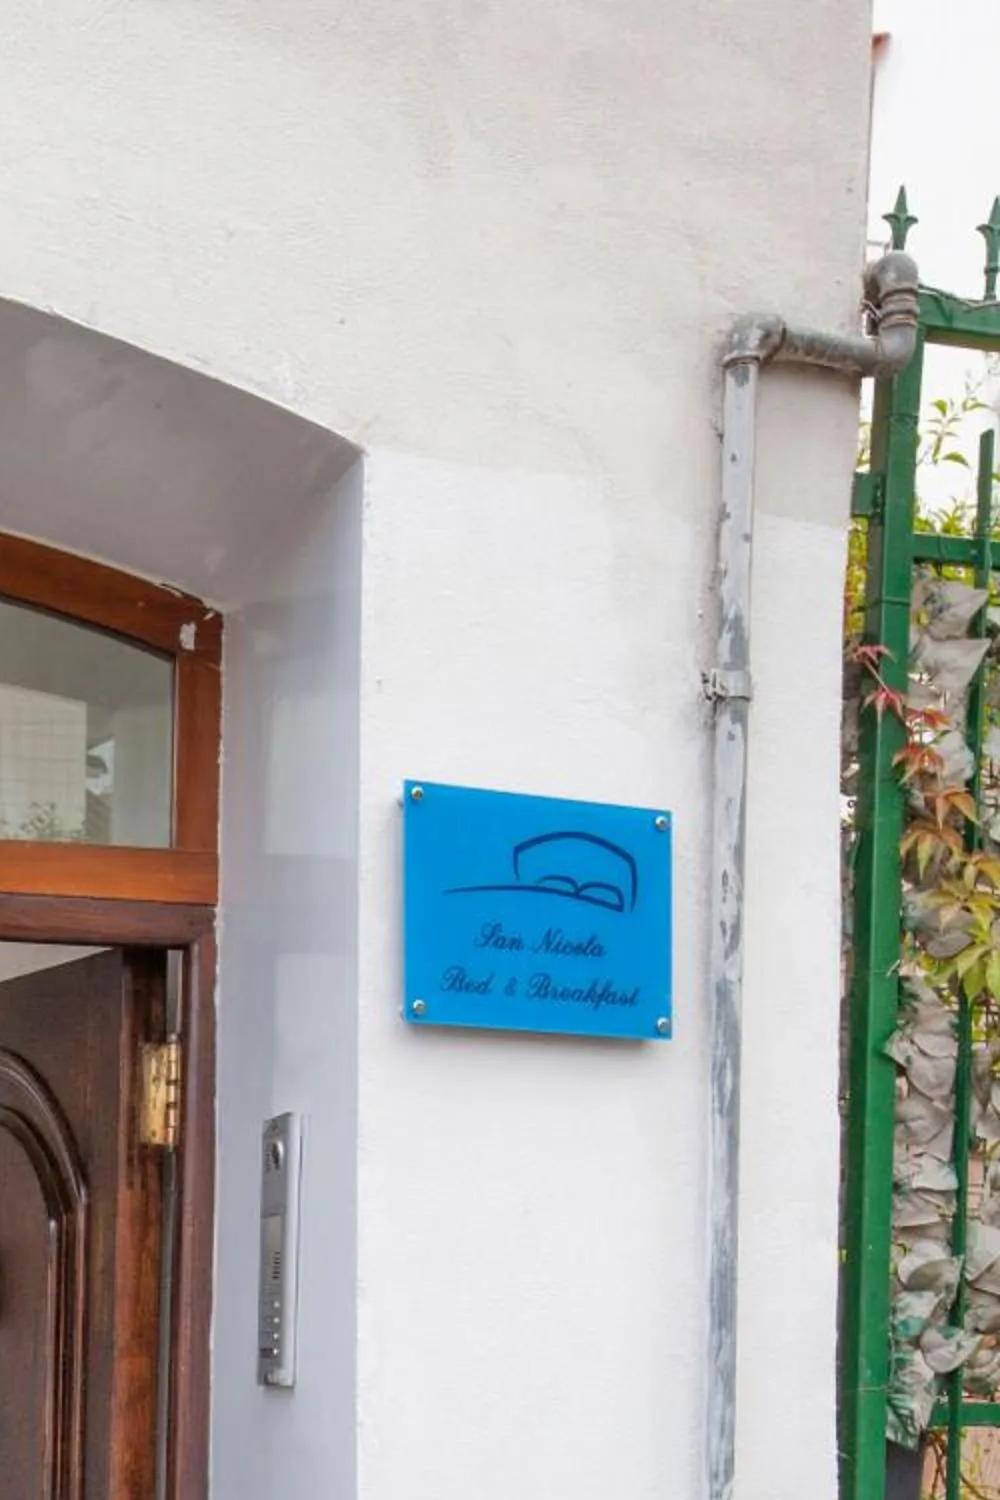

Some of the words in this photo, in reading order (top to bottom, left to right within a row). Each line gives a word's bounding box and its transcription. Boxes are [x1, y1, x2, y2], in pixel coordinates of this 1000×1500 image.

[474, 921, 525, 952] San
[532, 927, 607, 957] Nicola
[440, 965, 495, 994] Bed
[503, 976, 518, 998] &
[526, 972, 640, 1010] Breakfast
